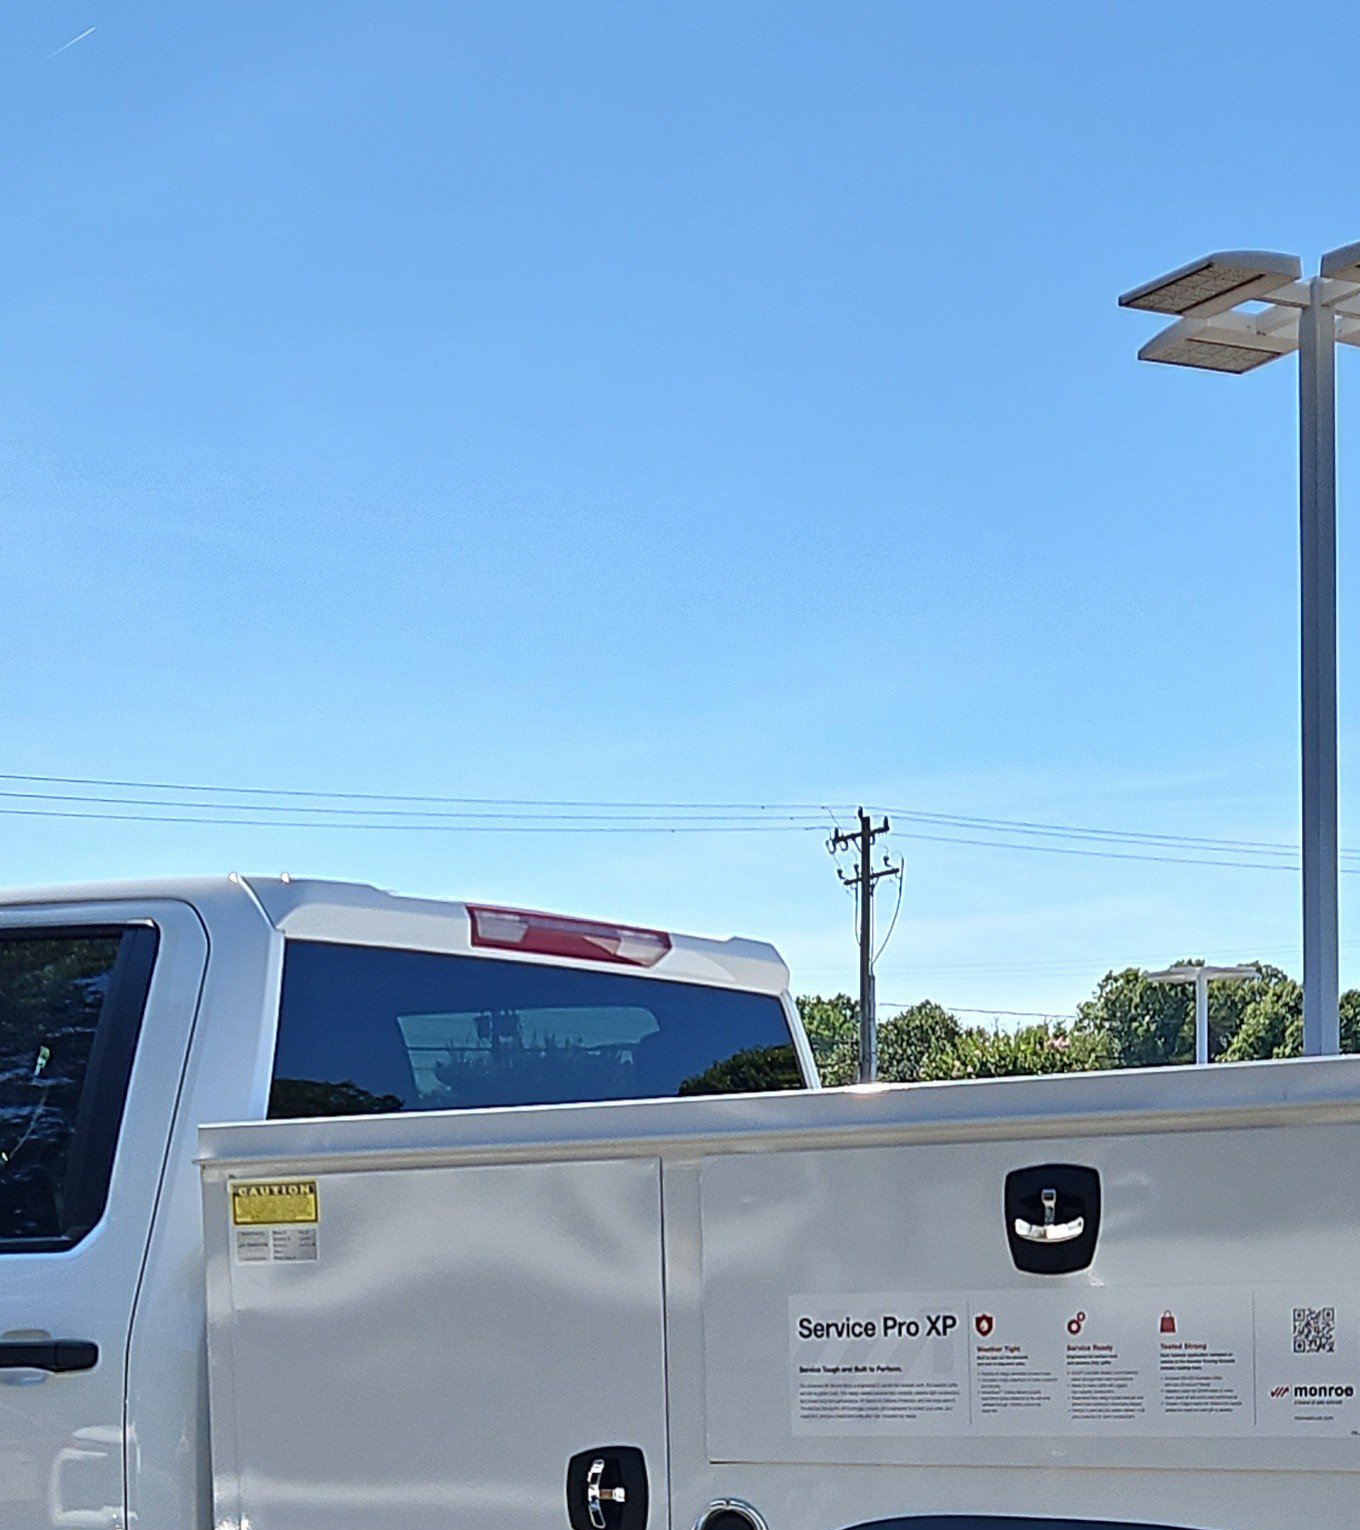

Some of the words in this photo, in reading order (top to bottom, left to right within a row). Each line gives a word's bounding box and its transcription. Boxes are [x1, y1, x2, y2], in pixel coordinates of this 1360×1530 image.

[238, 1185, 310, 1197] CAUTION
[798, 1316, 876, 1339] Service
[883, 1316, 920, 1338] Pro
[926, 1314, 958, 1337] XP
[1294, 1386, 1354, 1398] monroe
